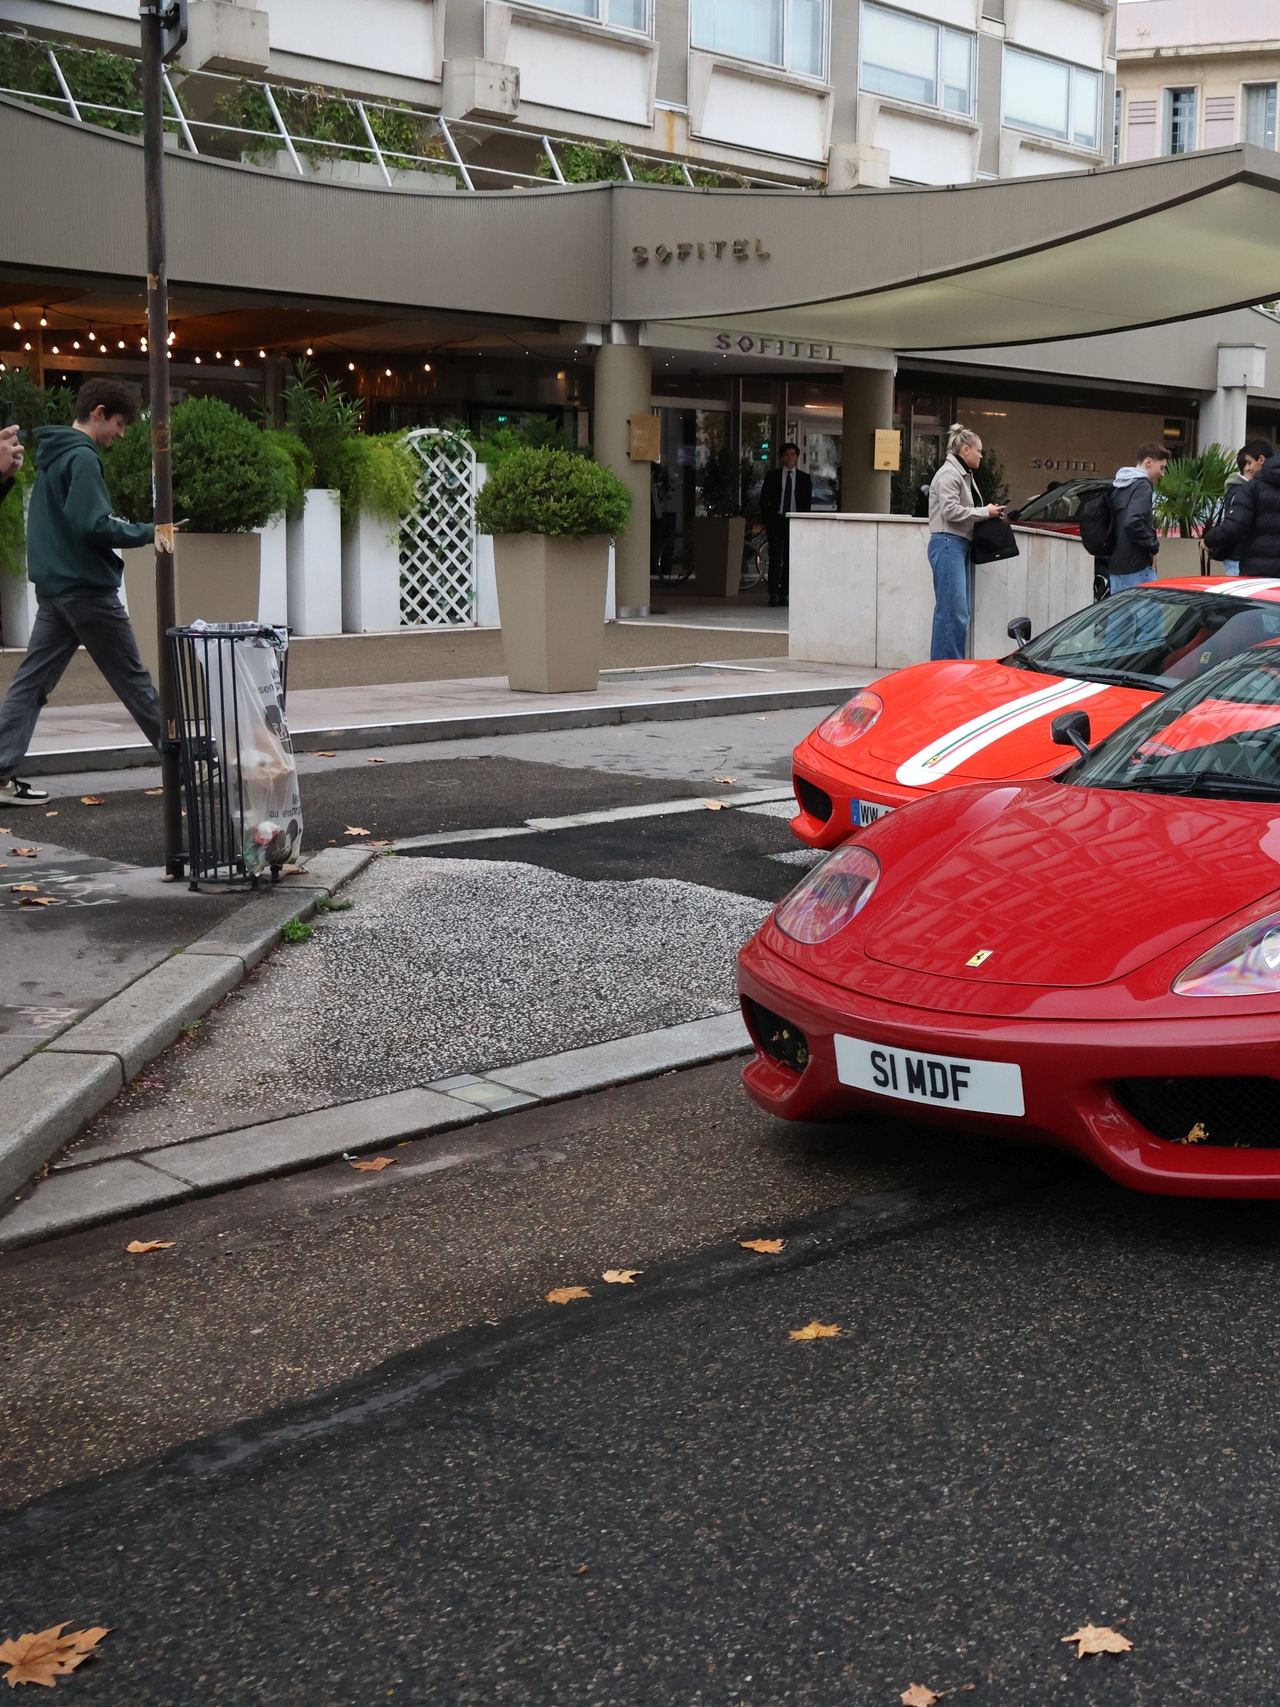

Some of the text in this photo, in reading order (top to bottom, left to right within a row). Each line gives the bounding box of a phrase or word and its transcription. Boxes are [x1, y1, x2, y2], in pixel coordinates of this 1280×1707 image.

[632, 237, 771, 266] SOFITEL
[715, 332, 841, 362] SOFITEL
[1032, 458, 1099, 472] SOFITEL
[905, 1057, 971, 1102] MDF
